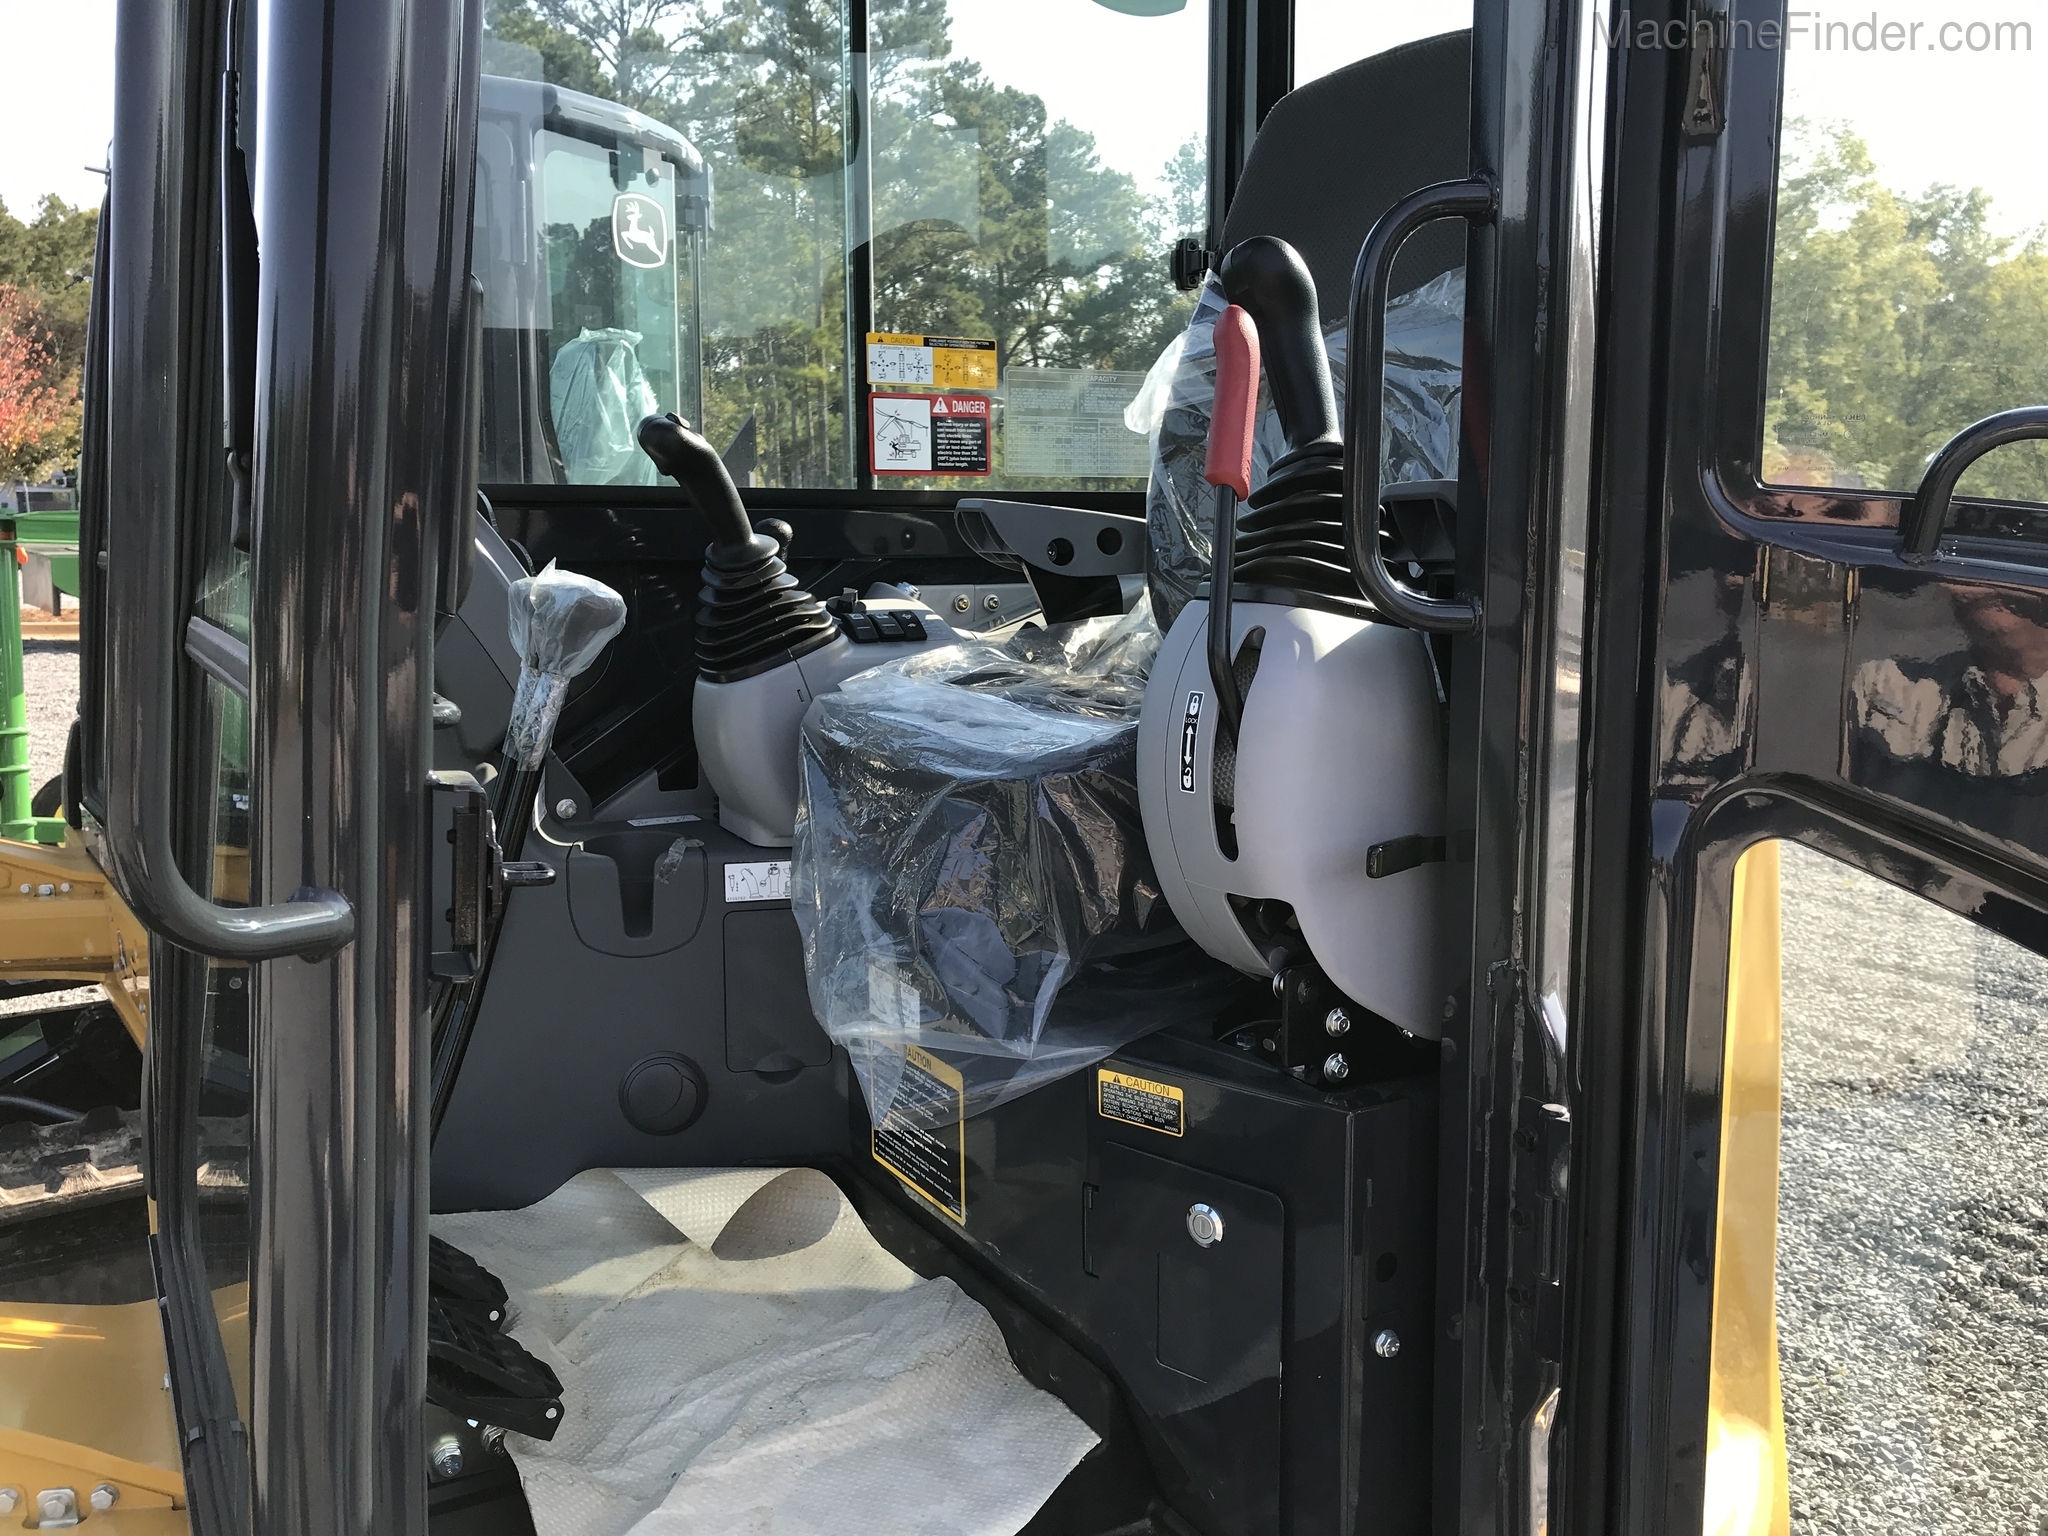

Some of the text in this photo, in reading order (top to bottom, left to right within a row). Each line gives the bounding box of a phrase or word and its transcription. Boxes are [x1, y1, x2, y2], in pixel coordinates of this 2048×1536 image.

[952, 400, 986, 414] DANGER
[905, 1046, 932, 1070] AUTION
[1126, 1076, 1170, 1096] CAUTION
[1163, 1097, 1179, 1106] BEFORE
[1159, 1107, 1178, 1116] CONTROL
